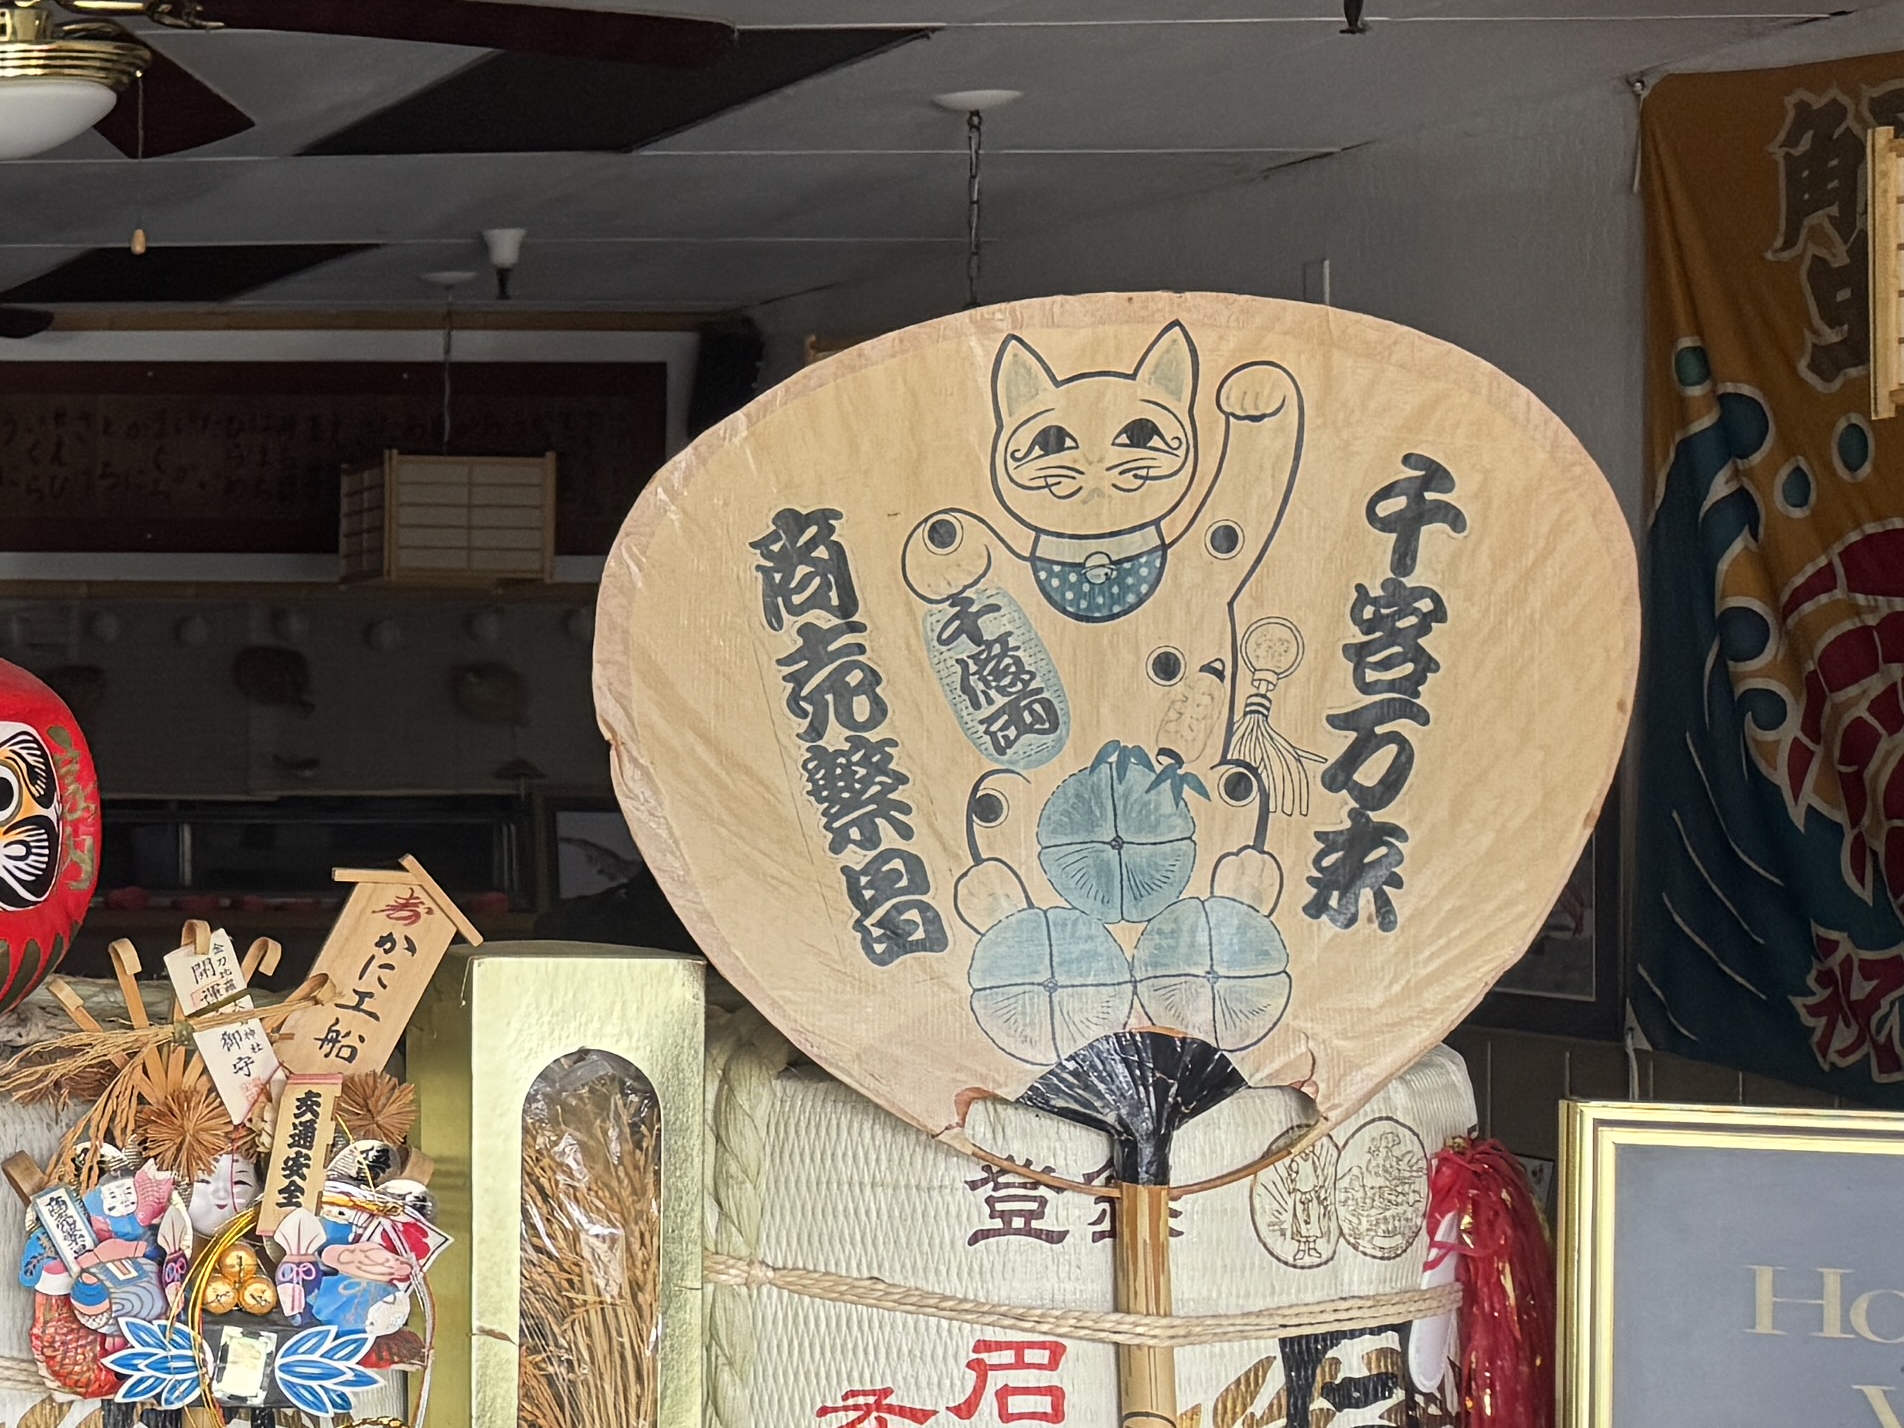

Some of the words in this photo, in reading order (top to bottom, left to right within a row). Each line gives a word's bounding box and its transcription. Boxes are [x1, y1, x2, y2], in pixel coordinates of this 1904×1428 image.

[313, 932, 417, 1064] かに工船
[275, 1089, 322, 1209] 交通安全
